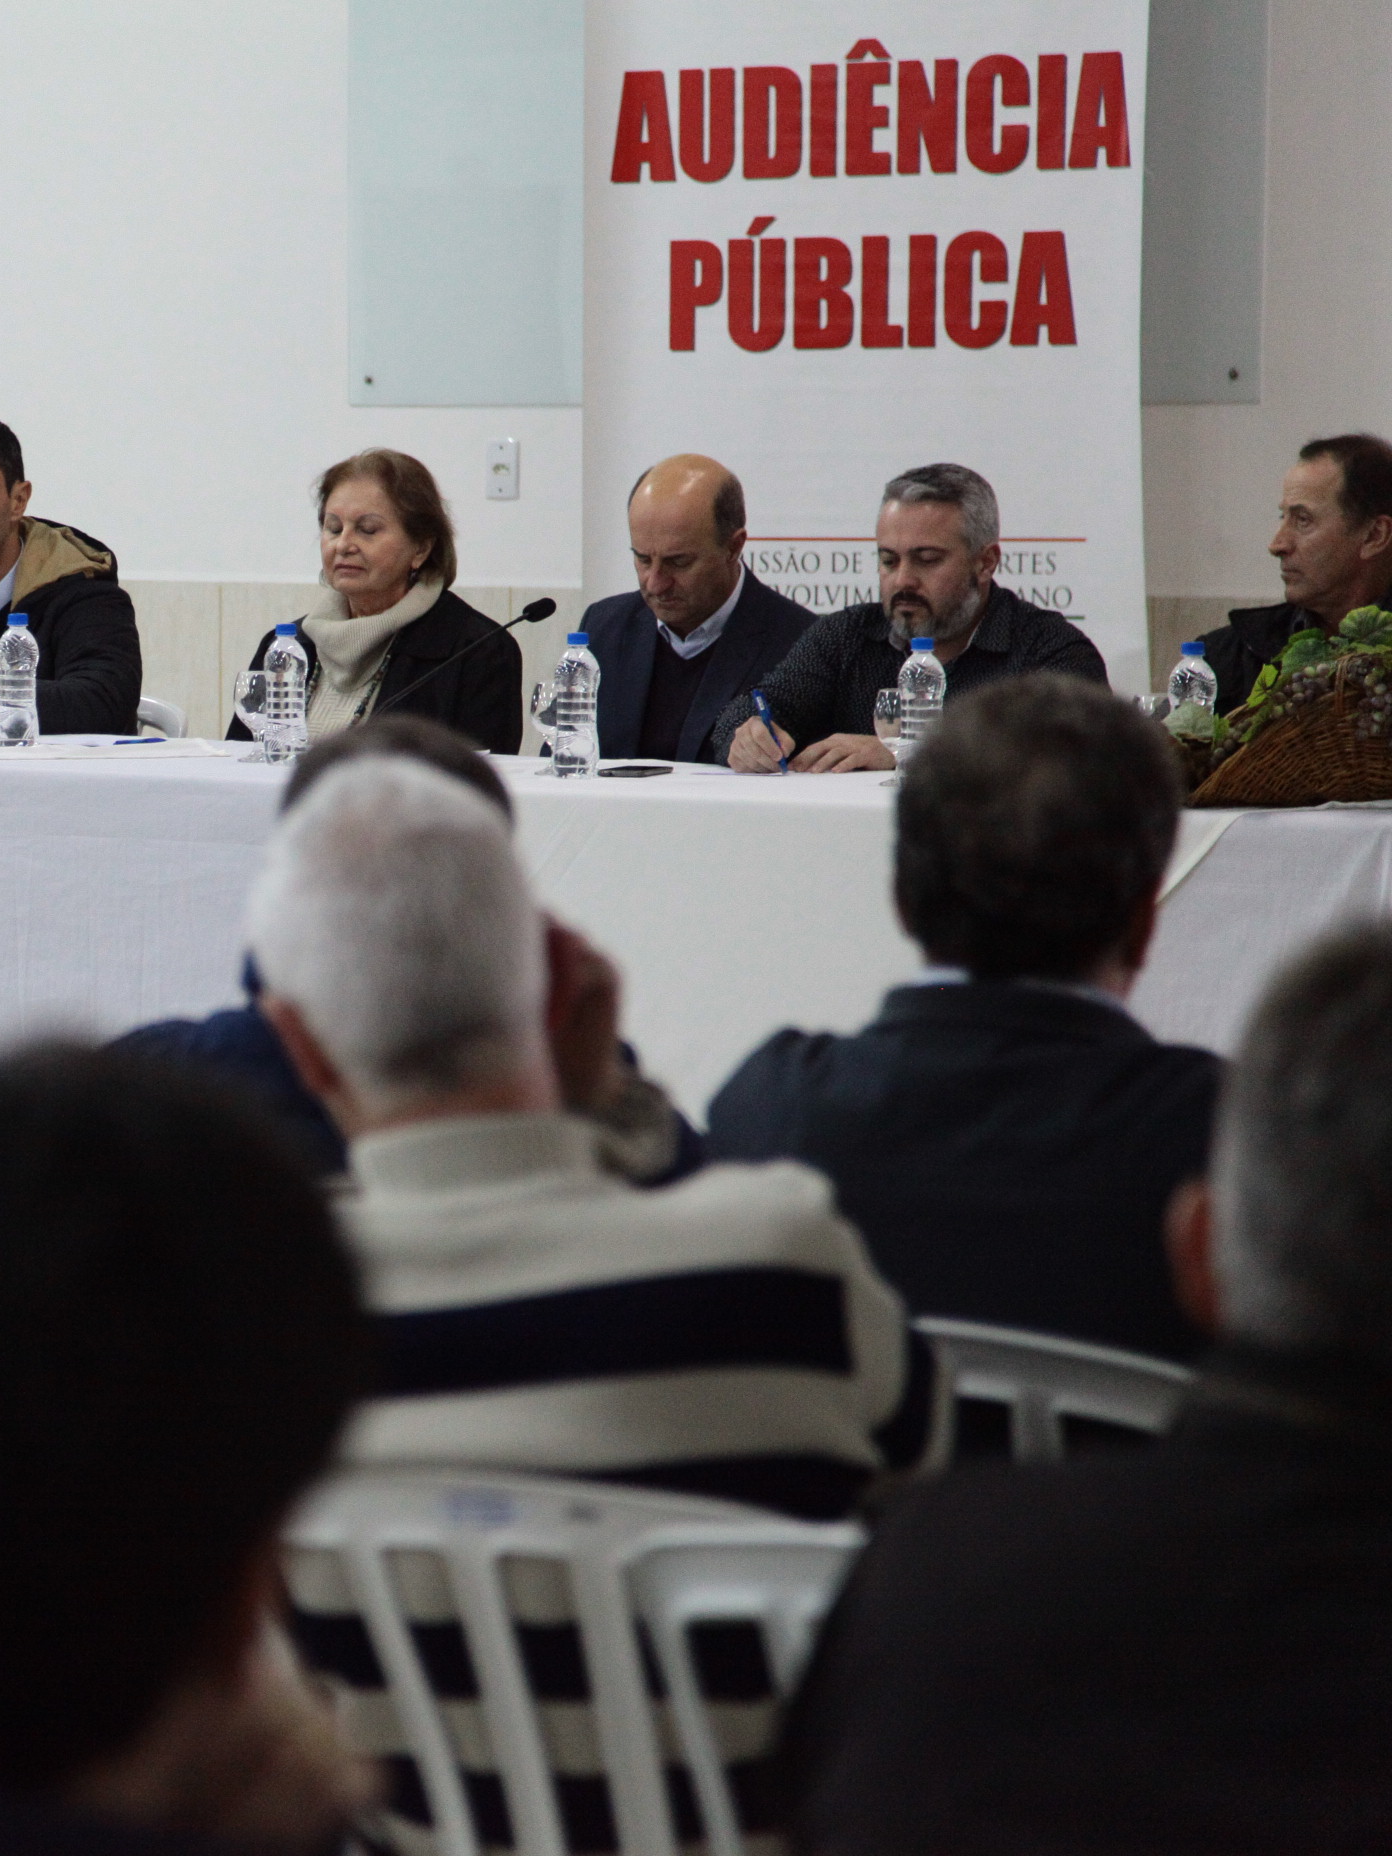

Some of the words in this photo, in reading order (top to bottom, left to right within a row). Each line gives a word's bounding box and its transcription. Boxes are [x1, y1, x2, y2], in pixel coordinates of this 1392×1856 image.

[611, 38, 1131, 184] AUDIÊNCIA
[669, 216, 1078, 352] PÚBLICA
[741, 547, 821, 574] ISSÃO
[831, 551, 862, 574] DE
